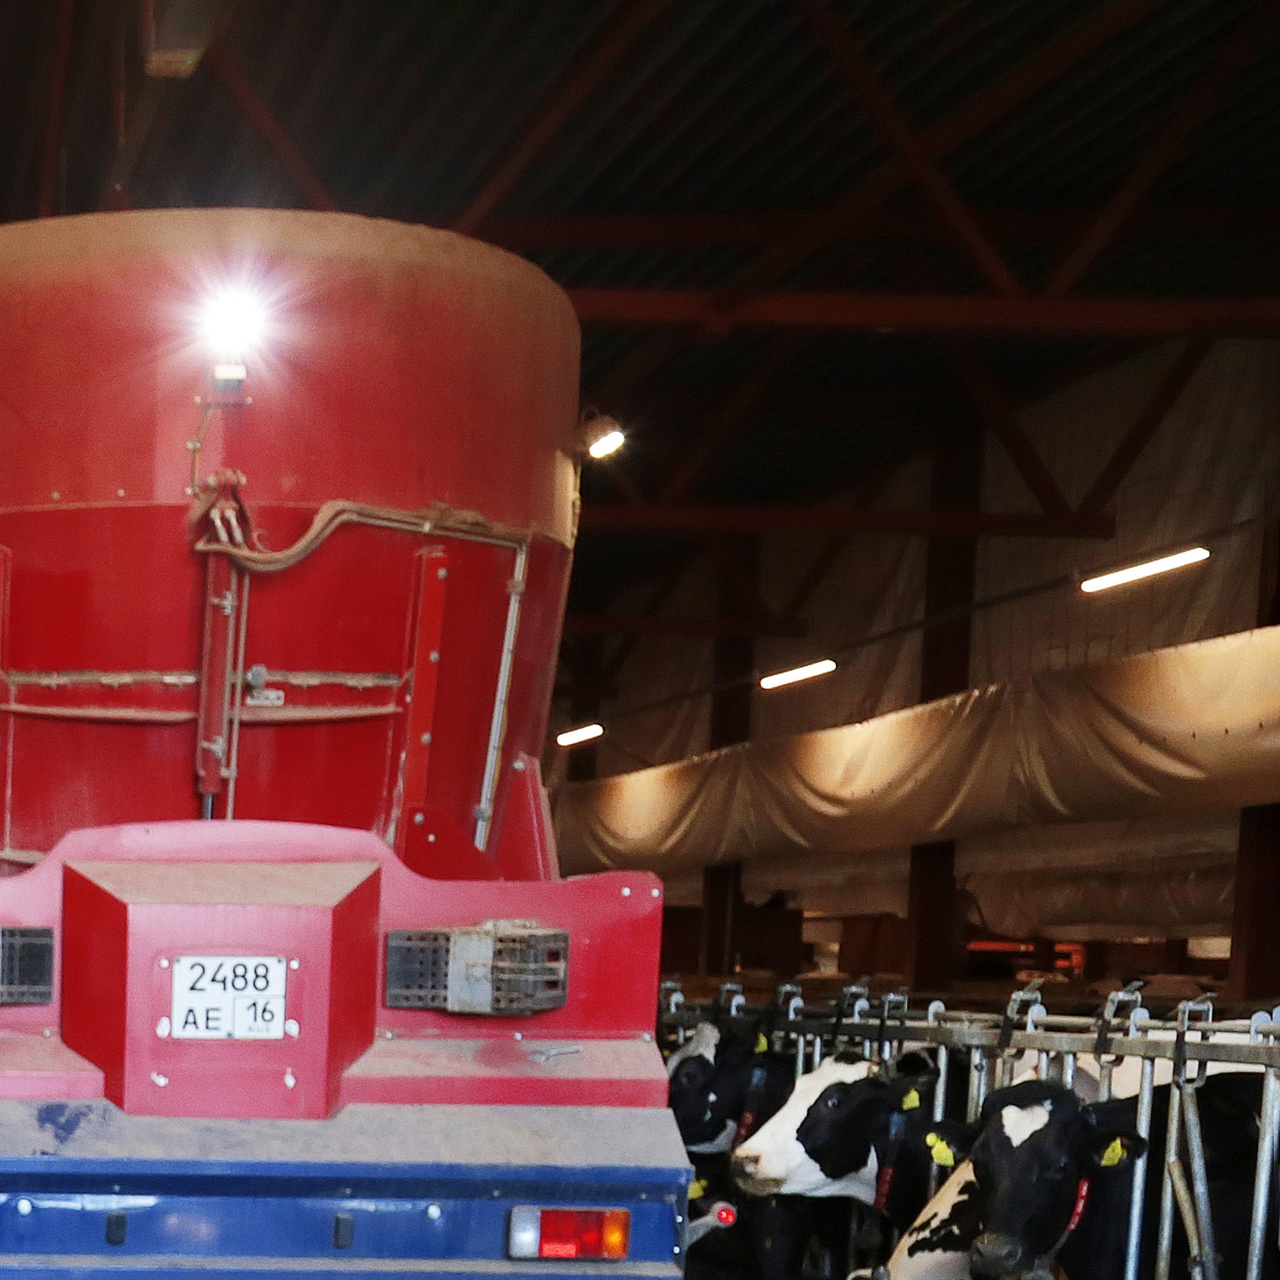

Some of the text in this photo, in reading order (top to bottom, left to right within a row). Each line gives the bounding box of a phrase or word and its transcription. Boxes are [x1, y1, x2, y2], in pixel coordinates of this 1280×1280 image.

[189, 962, 270, 992] 2488
[182, 1001, 275, 1031] AE 16
